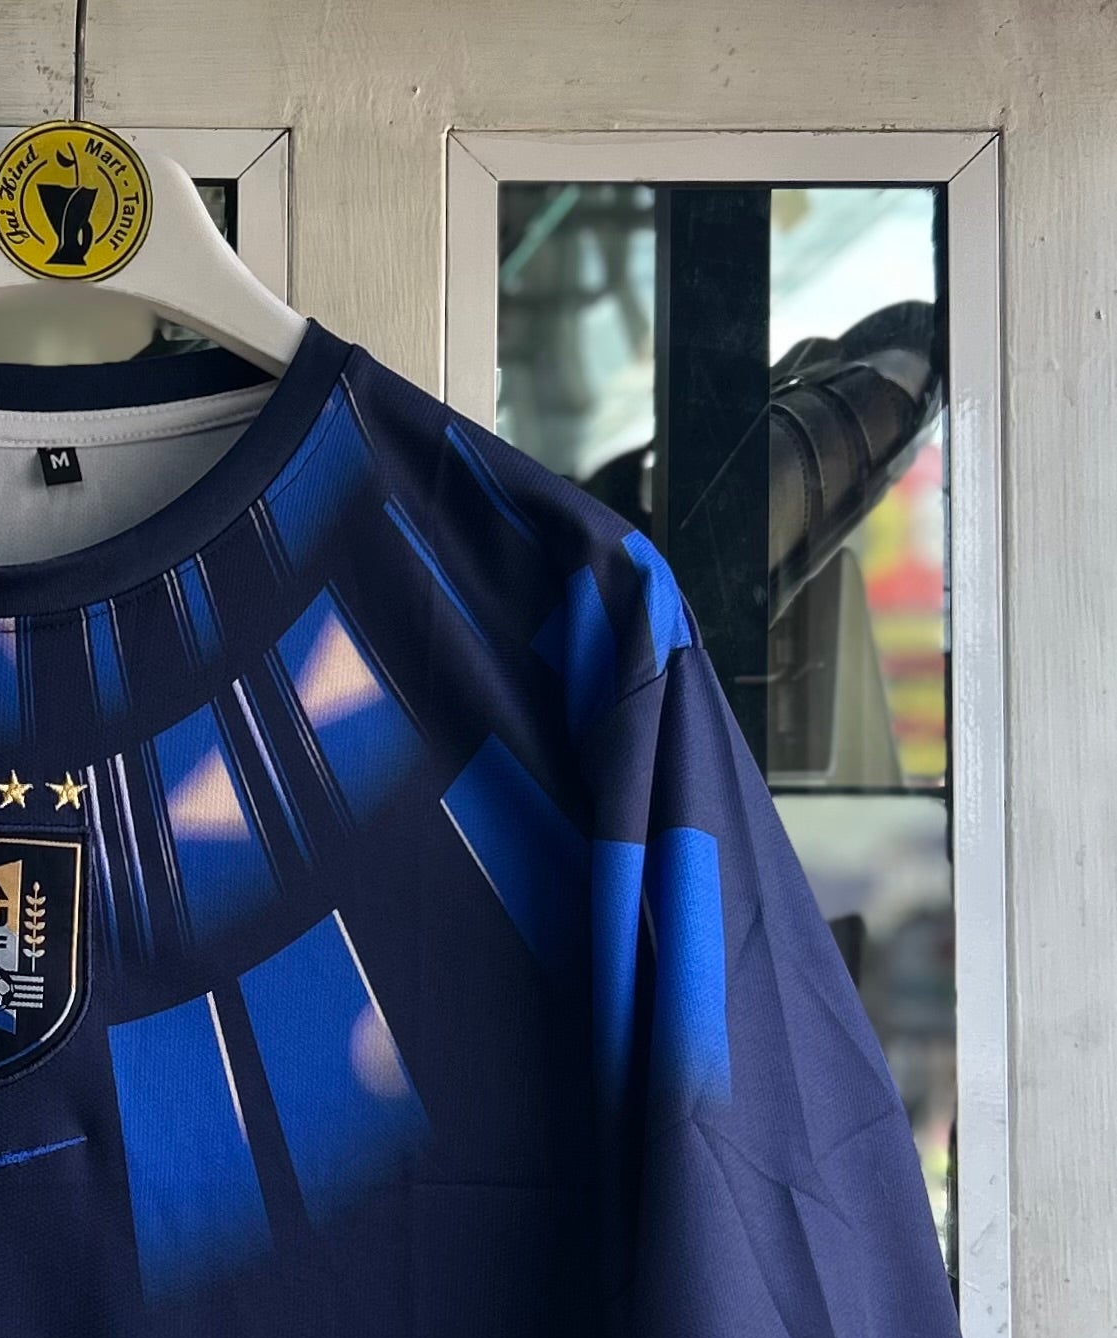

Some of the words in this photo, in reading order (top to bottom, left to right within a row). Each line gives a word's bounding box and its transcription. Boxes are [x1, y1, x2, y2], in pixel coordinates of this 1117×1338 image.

[85, 138, 127, 177] Mart
[109, 192, 140, 251] Tanur
[0, 207, 30, 245] Jai
[50, 451, 70, 470] M
